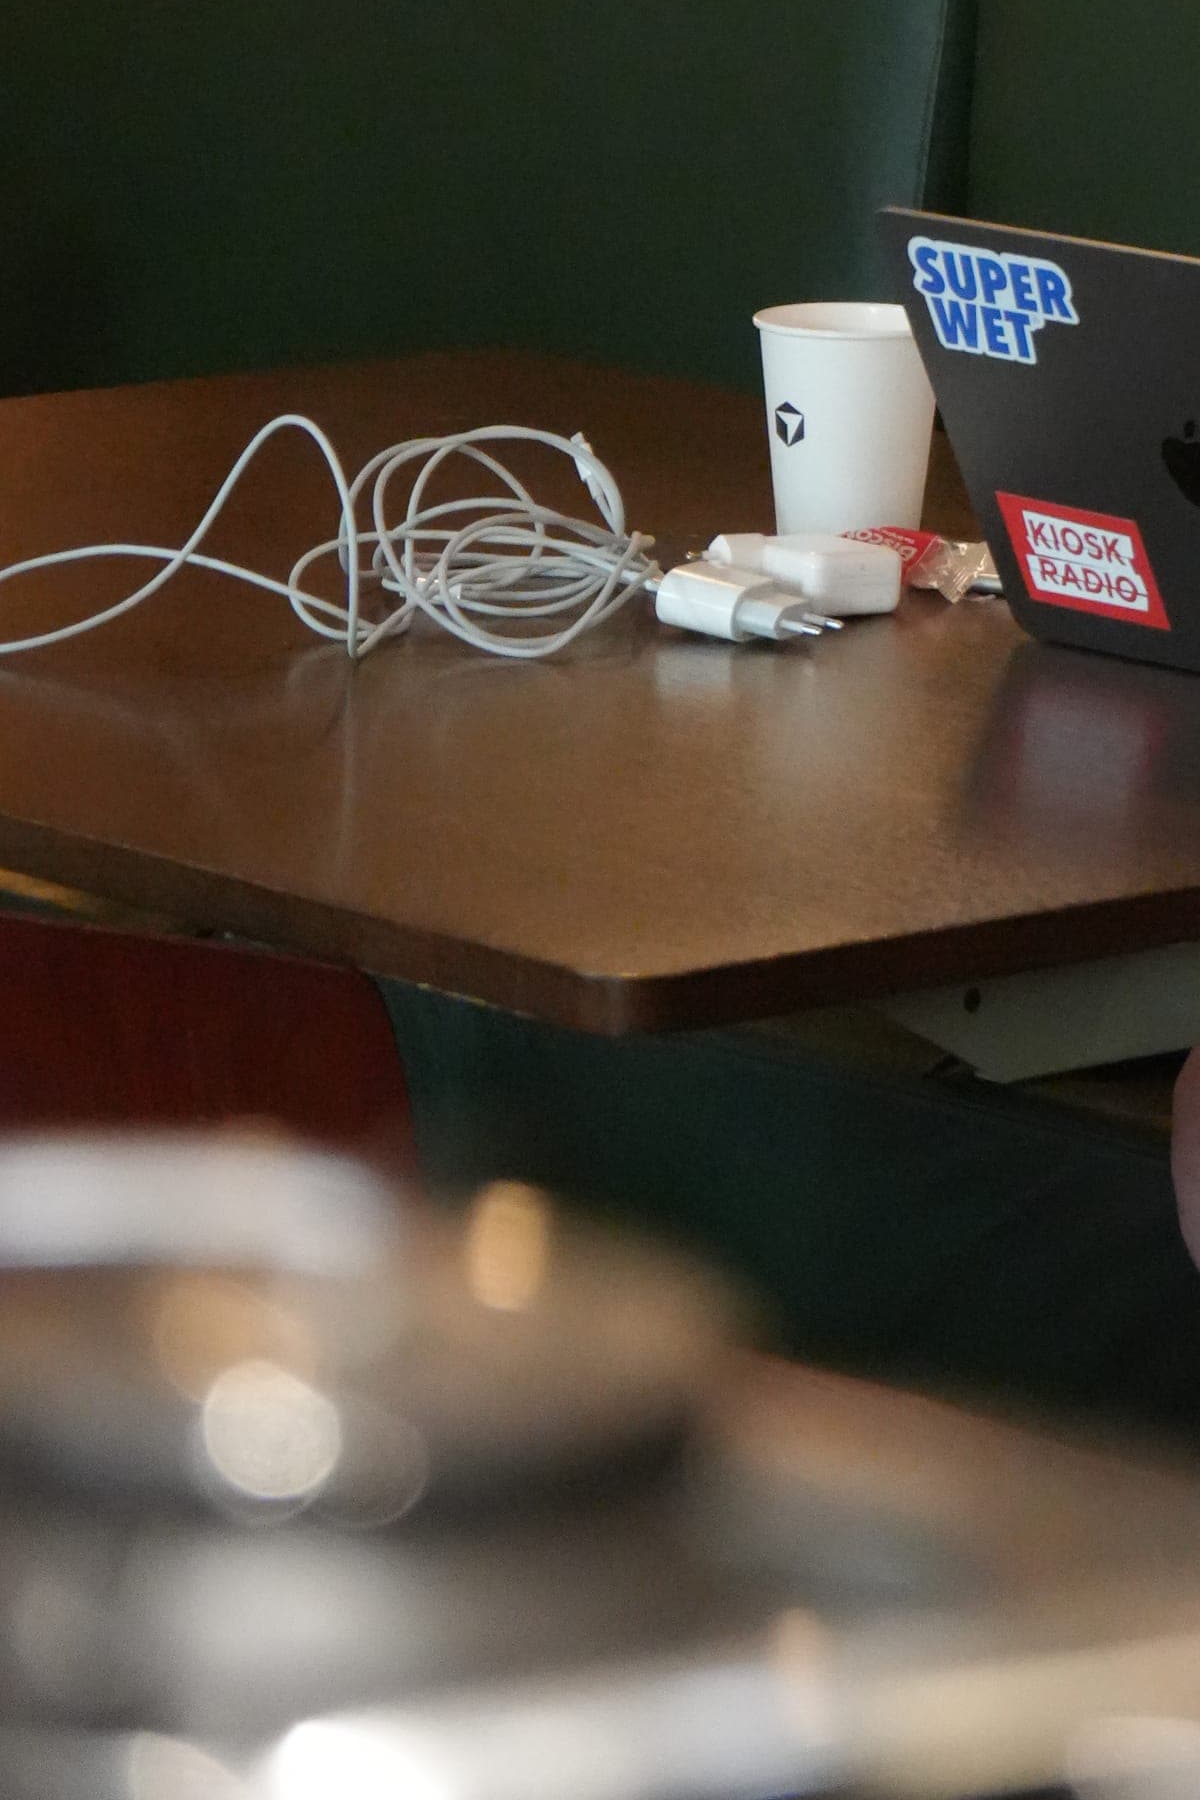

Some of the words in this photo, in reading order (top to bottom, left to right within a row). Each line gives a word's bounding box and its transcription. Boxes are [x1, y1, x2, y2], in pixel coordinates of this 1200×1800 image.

[915, 246, 1072, 318] SUPER
[931, 296, 1031, 359] WET
[1028, 519, 1126, 567] KIOSK
[1038, 557, 1138, 603] RADIO
